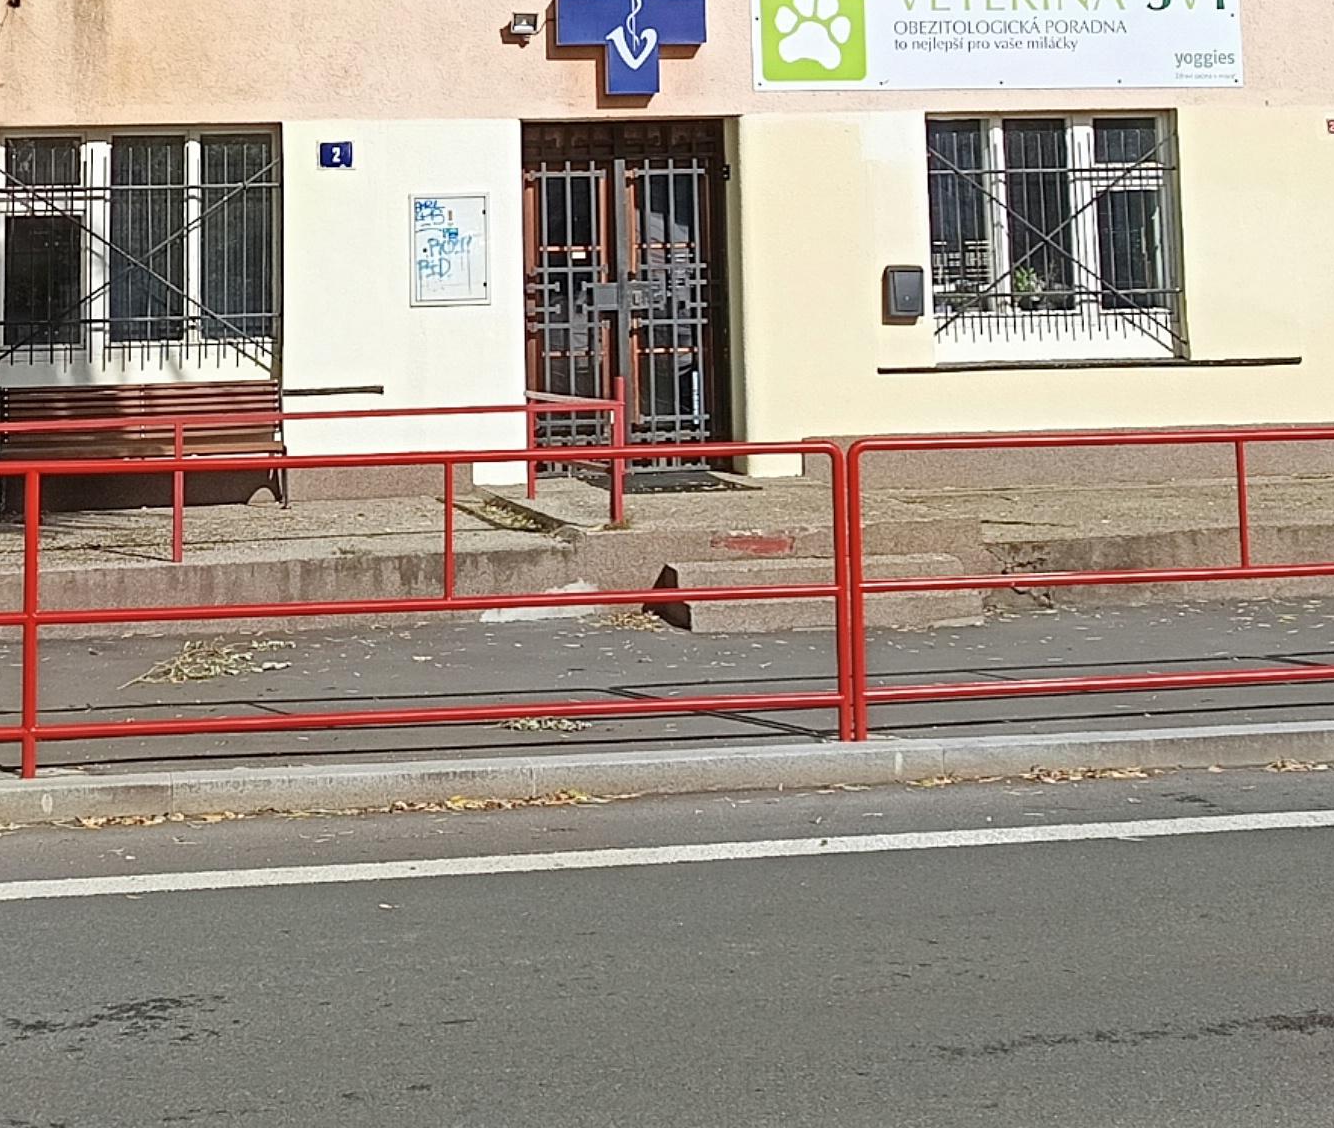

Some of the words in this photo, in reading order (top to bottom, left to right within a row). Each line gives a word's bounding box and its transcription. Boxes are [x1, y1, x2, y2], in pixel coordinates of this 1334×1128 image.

[893, 16, 1041, 35] OBEZITOLOGICKÁ
[1045, 19, 1128, 34] PORADNA
[894, 37, 907, 50] to
[911, 36, 964, 53] nejlepší
[967, 39, 991, 52] pro
[993, 36, 1023, 50] vaše
[1026, 35, 1078, 51] miláčky
[1174, 49, 1236, 69] yoggies
[331, 147, 341, 163] 2
